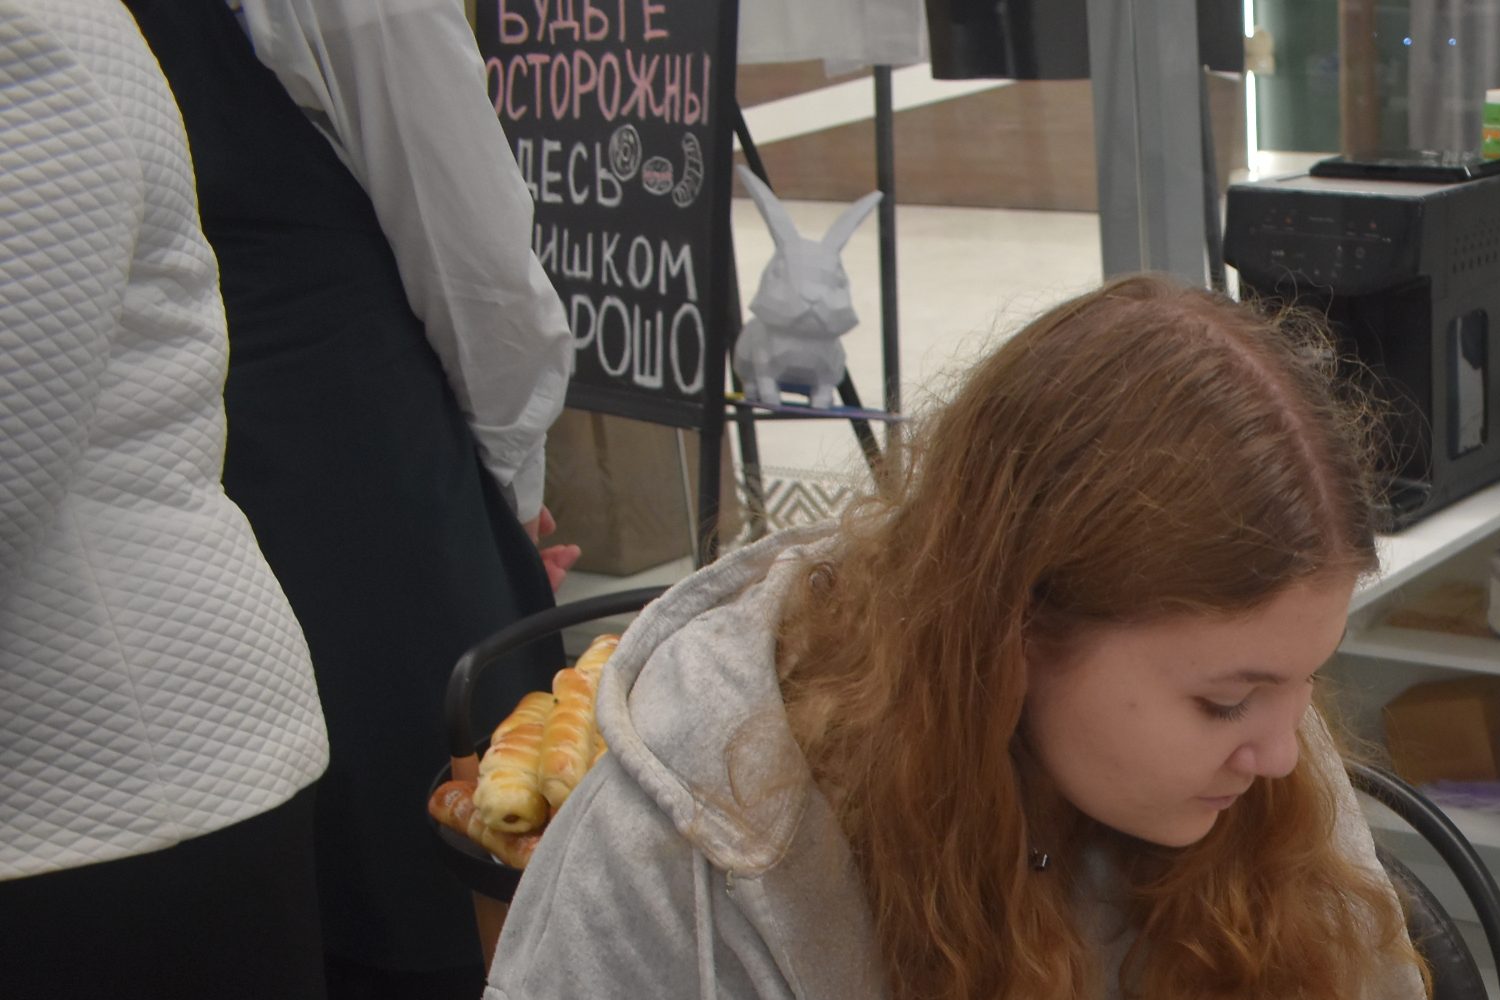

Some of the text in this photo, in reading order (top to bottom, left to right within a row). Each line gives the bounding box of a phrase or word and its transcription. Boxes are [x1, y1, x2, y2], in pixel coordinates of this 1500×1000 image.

[487, 50, 710, 125] ОСТОРОЖНЫ
[517, 138, 623, 207] ДЕСЬ
[535, 223, 699, 300] ИШКОМ
[570, 294, 705, 394] РОШО
